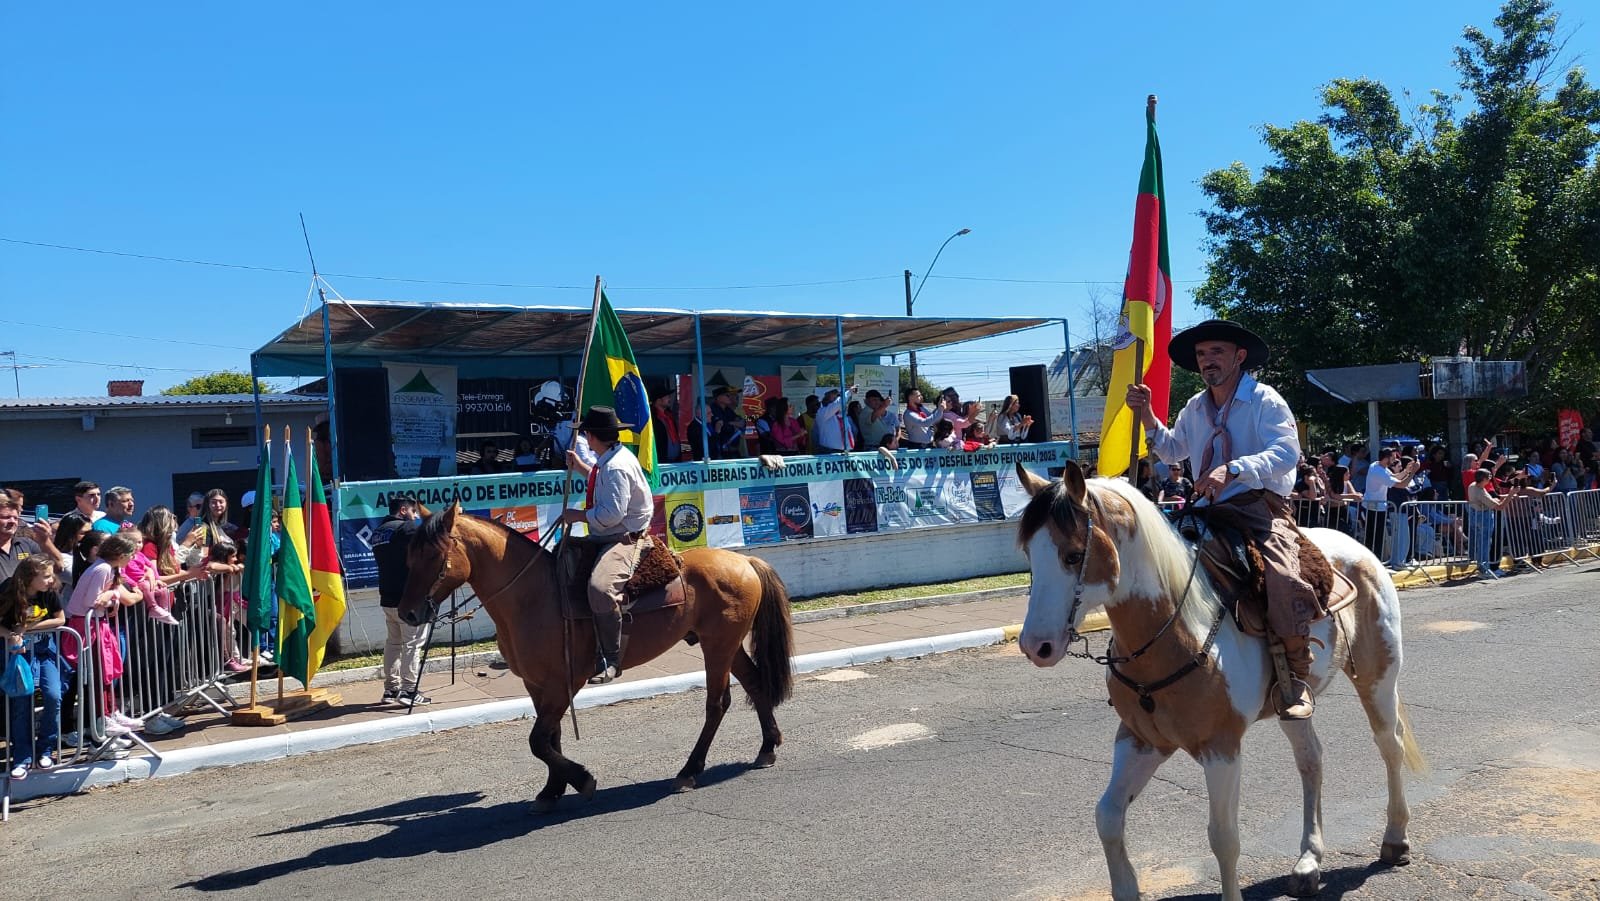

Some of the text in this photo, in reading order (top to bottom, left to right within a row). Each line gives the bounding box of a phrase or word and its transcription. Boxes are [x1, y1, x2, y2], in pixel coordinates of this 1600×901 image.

[460, 393, 504, 402] Tele-Entrega
[465, 402, 512, 413] 99370.1616
[476, 483, 495, 501] DE
[701, 466, 747, 483] LIBERAIS
[750, 465, 766, 480] DA
[768, 463, 814, 479] FEITORIA
[816, 461, 823, 475] E
[909, 457, 922, 469] DO
[940, 454, 973, 468] DESFILE
[974, 451, 999, 466] MISTO
